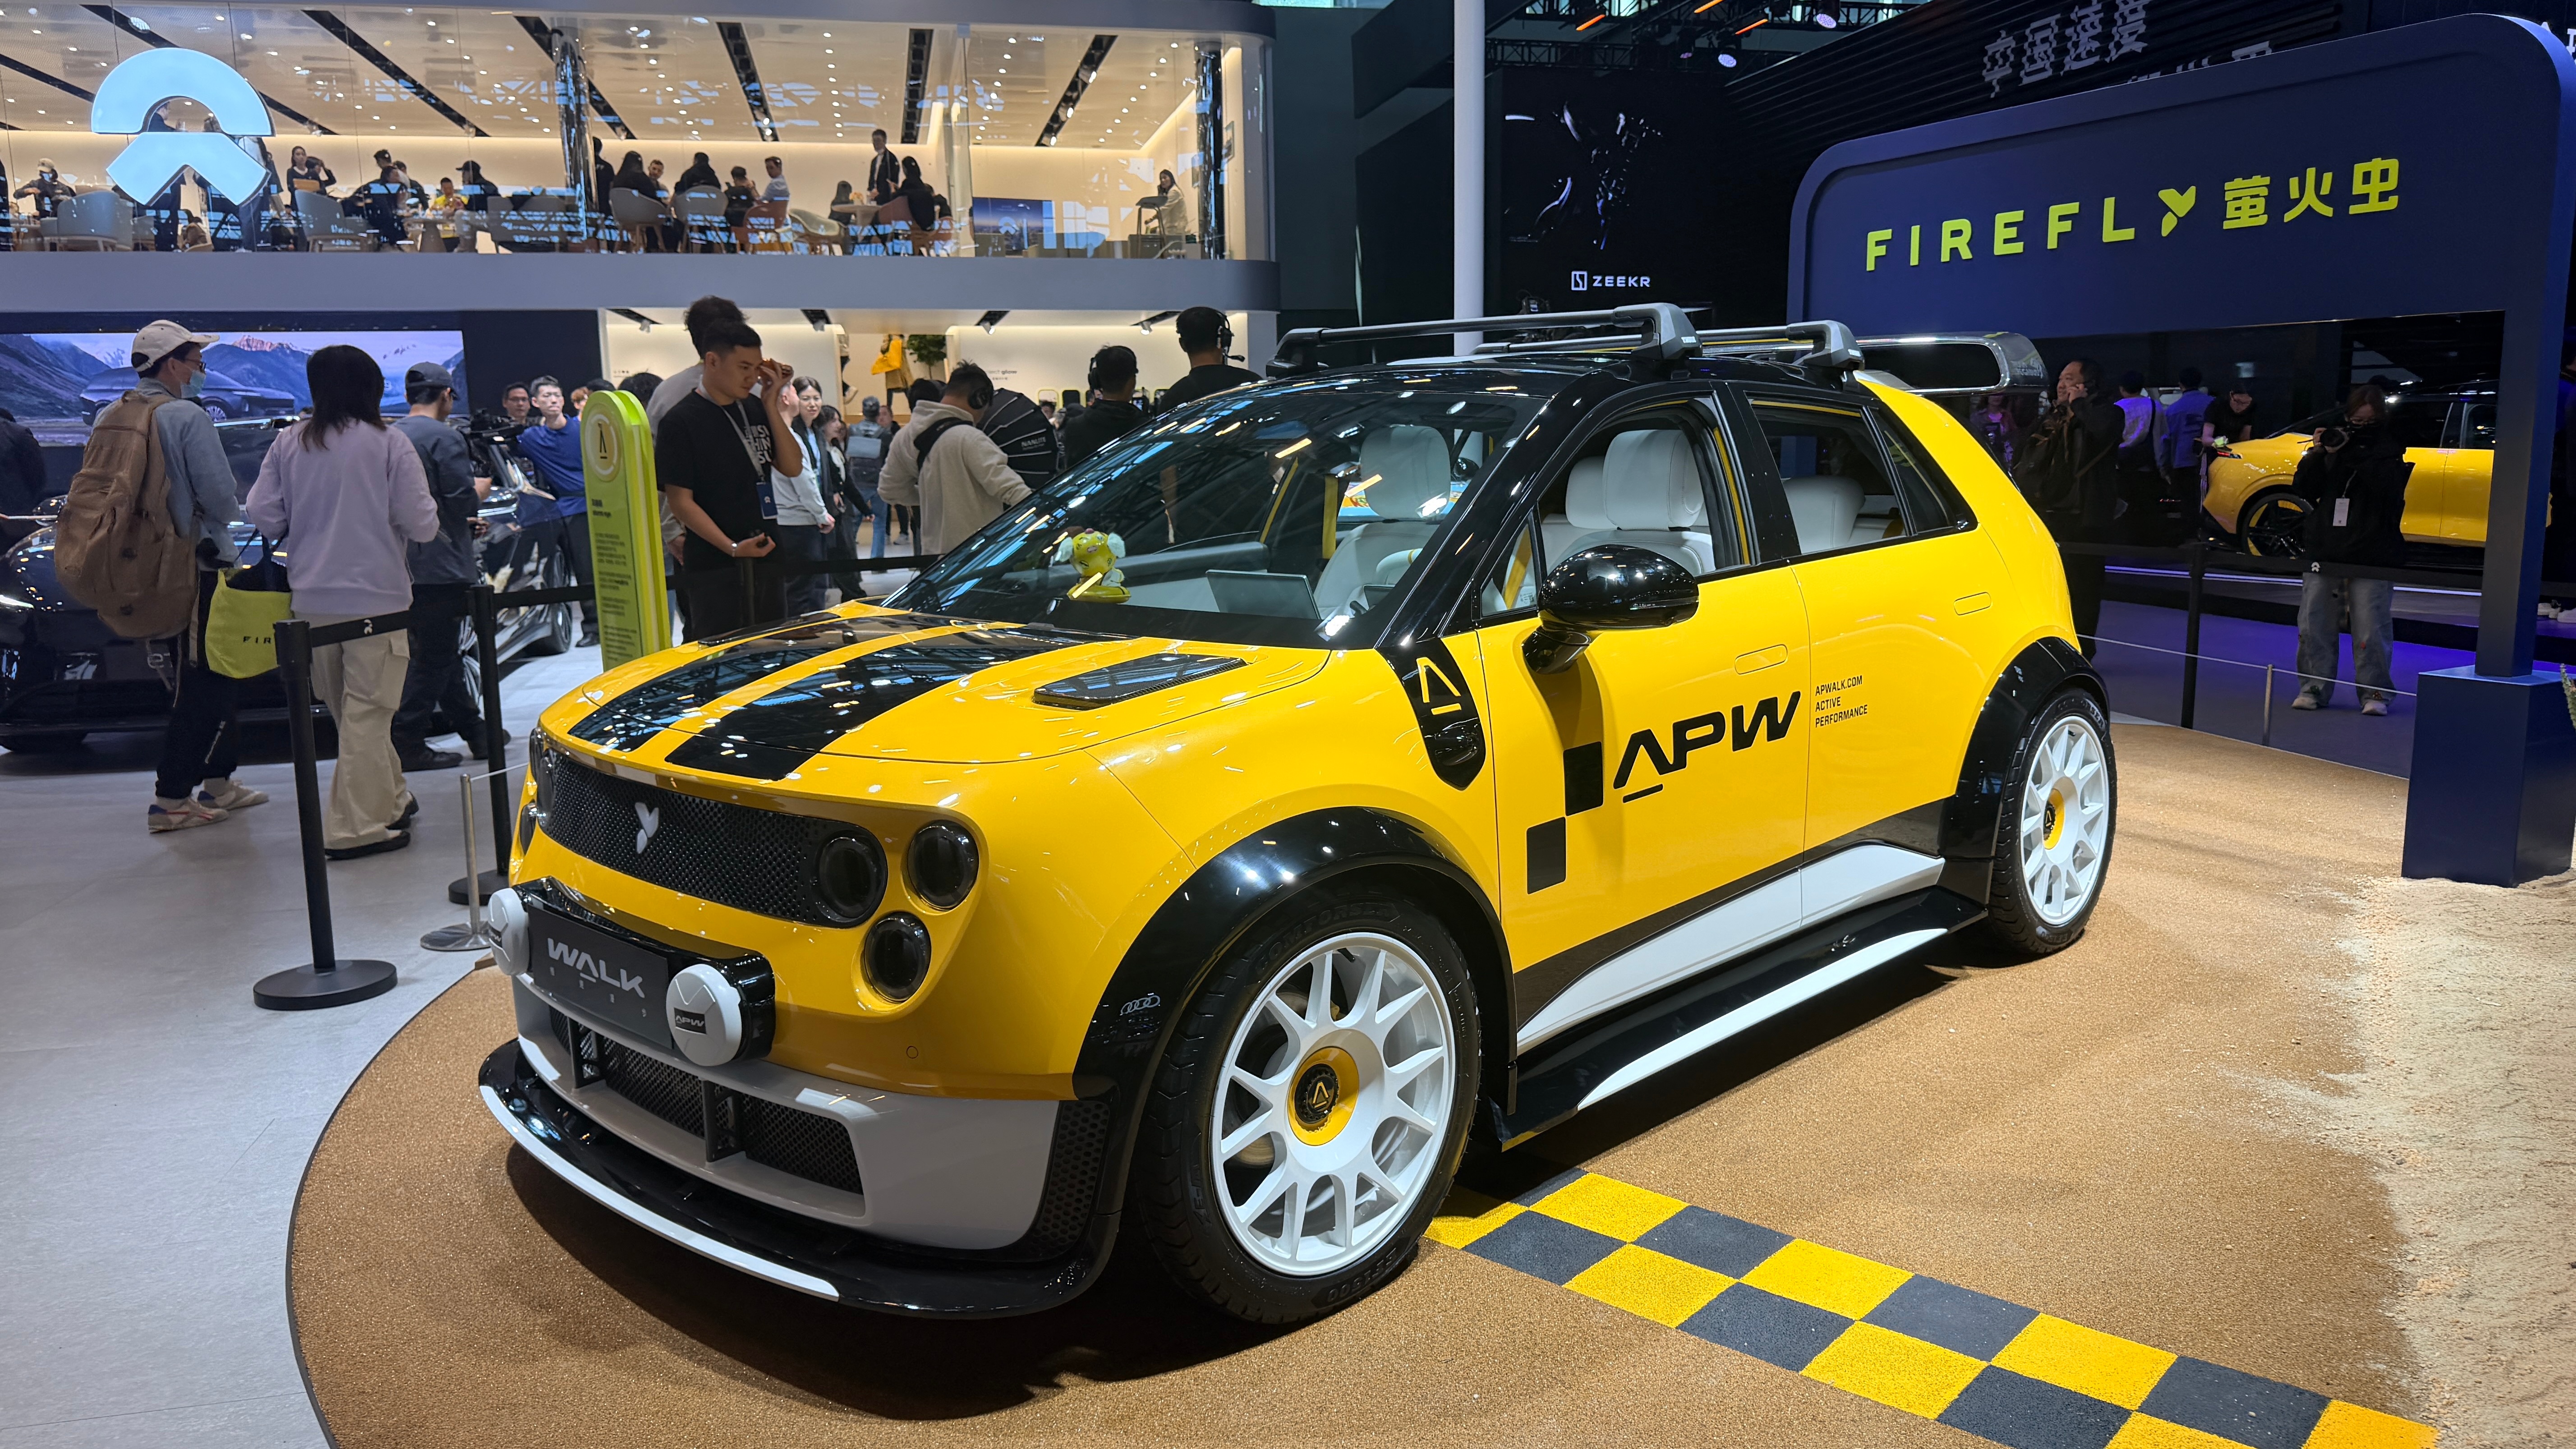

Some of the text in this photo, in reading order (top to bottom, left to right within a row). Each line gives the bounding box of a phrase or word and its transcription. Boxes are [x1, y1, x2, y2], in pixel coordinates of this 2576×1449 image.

[1866, 158, 2399, 271] FIREFLY 萤火虫
[1592, 276, 1651, 287] ZEEKR
[1815, 675, 1862, 696] APWALK.COM
[1815, 696, 1841, 712] ACTIVE
[1816, 704, 1868, 728] PERFORMANCE
[1613, 691, 1801, 803] APW
[547, 938, 645, 998] WALK
[676, 1015, 704, 1027] APW
